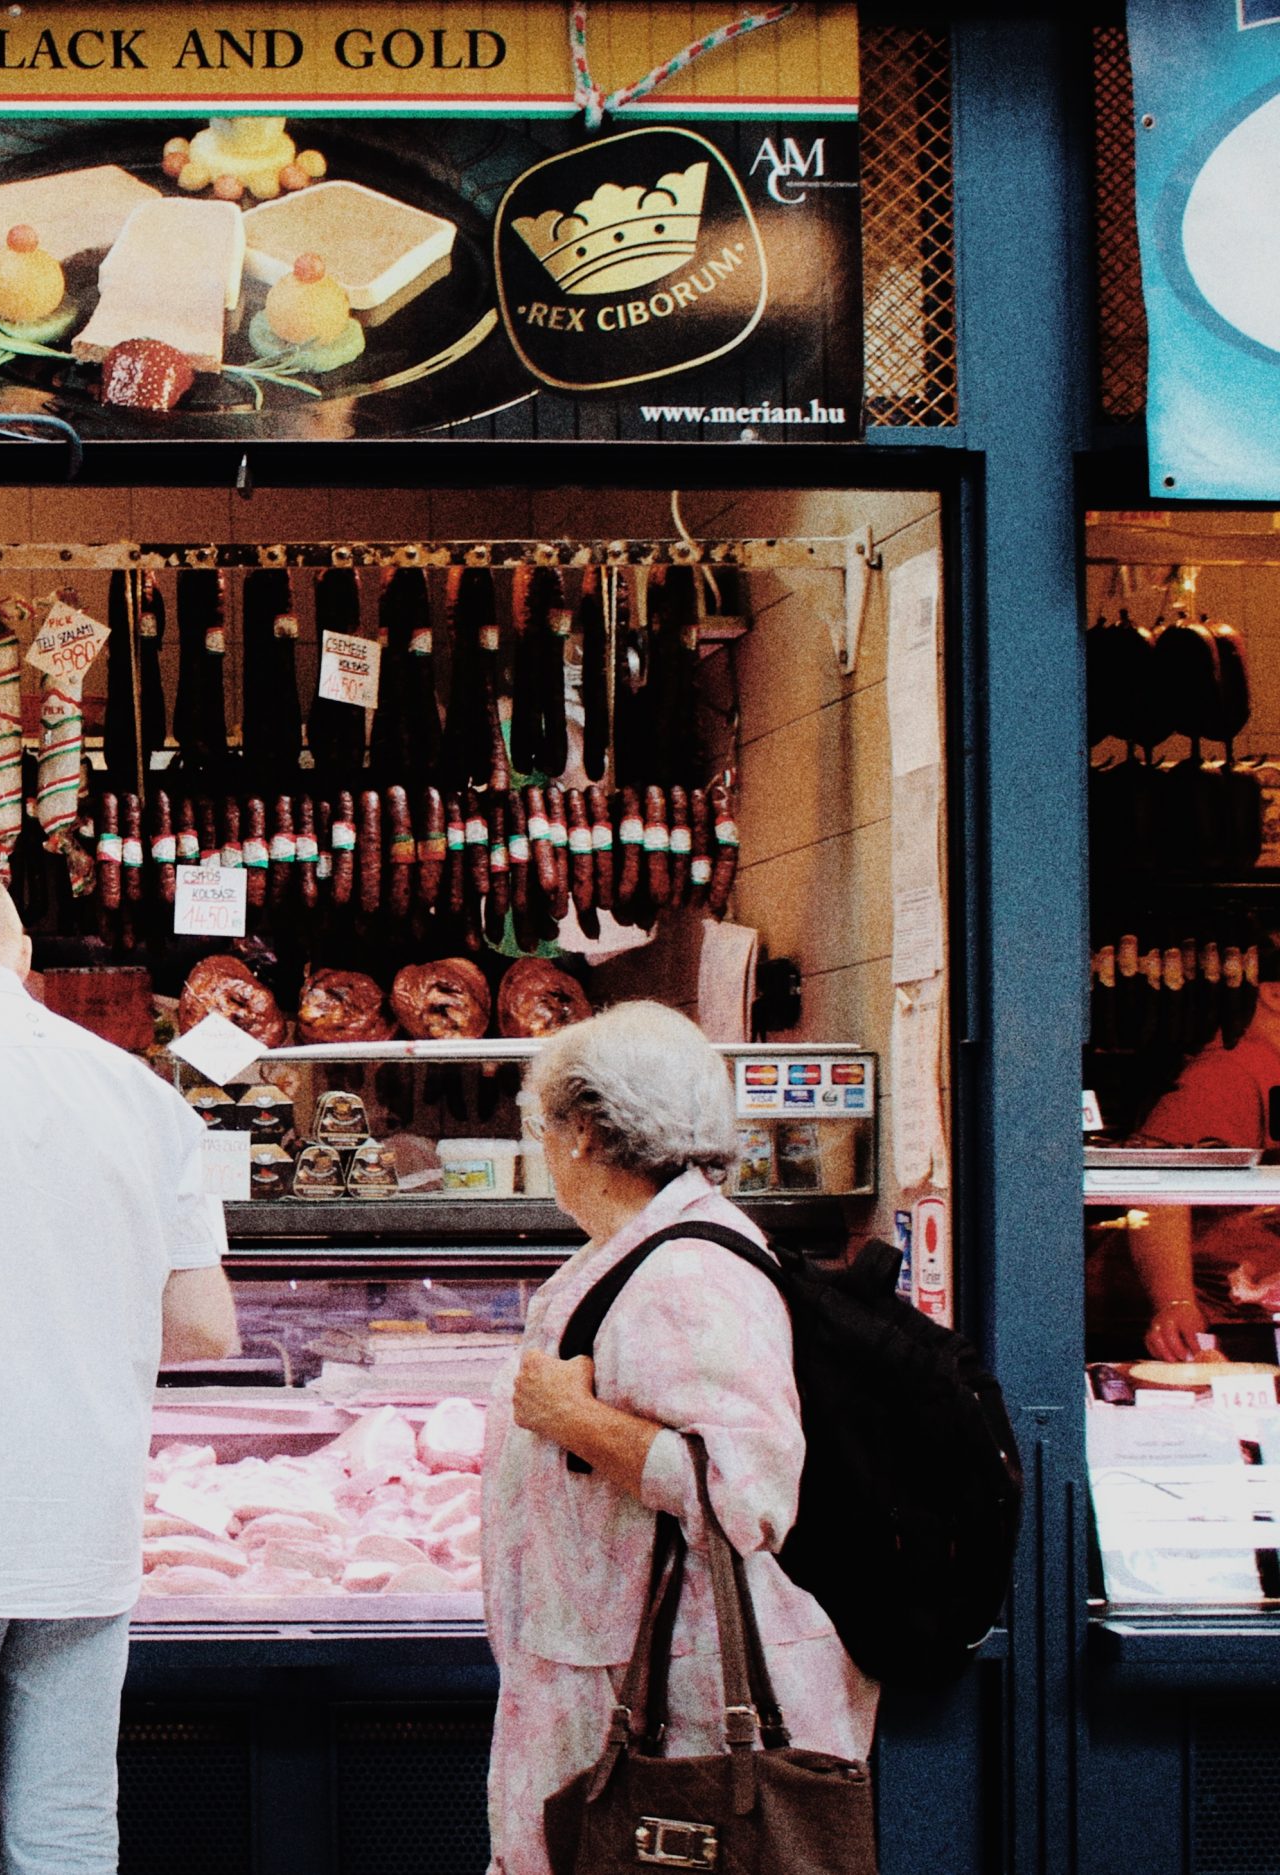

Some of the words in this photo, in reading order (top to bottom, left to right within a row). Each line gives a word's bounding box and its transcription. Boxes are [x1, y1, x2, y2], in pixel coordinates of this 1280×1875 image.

[173, 28, 304, 69] AND
[333, 28, 507, 70] GOLD
[527, 302, 586, 332] REX
[597, 250, 735, 333] CIBORUM
[640, 399, 846, 425] www.merian.hu
